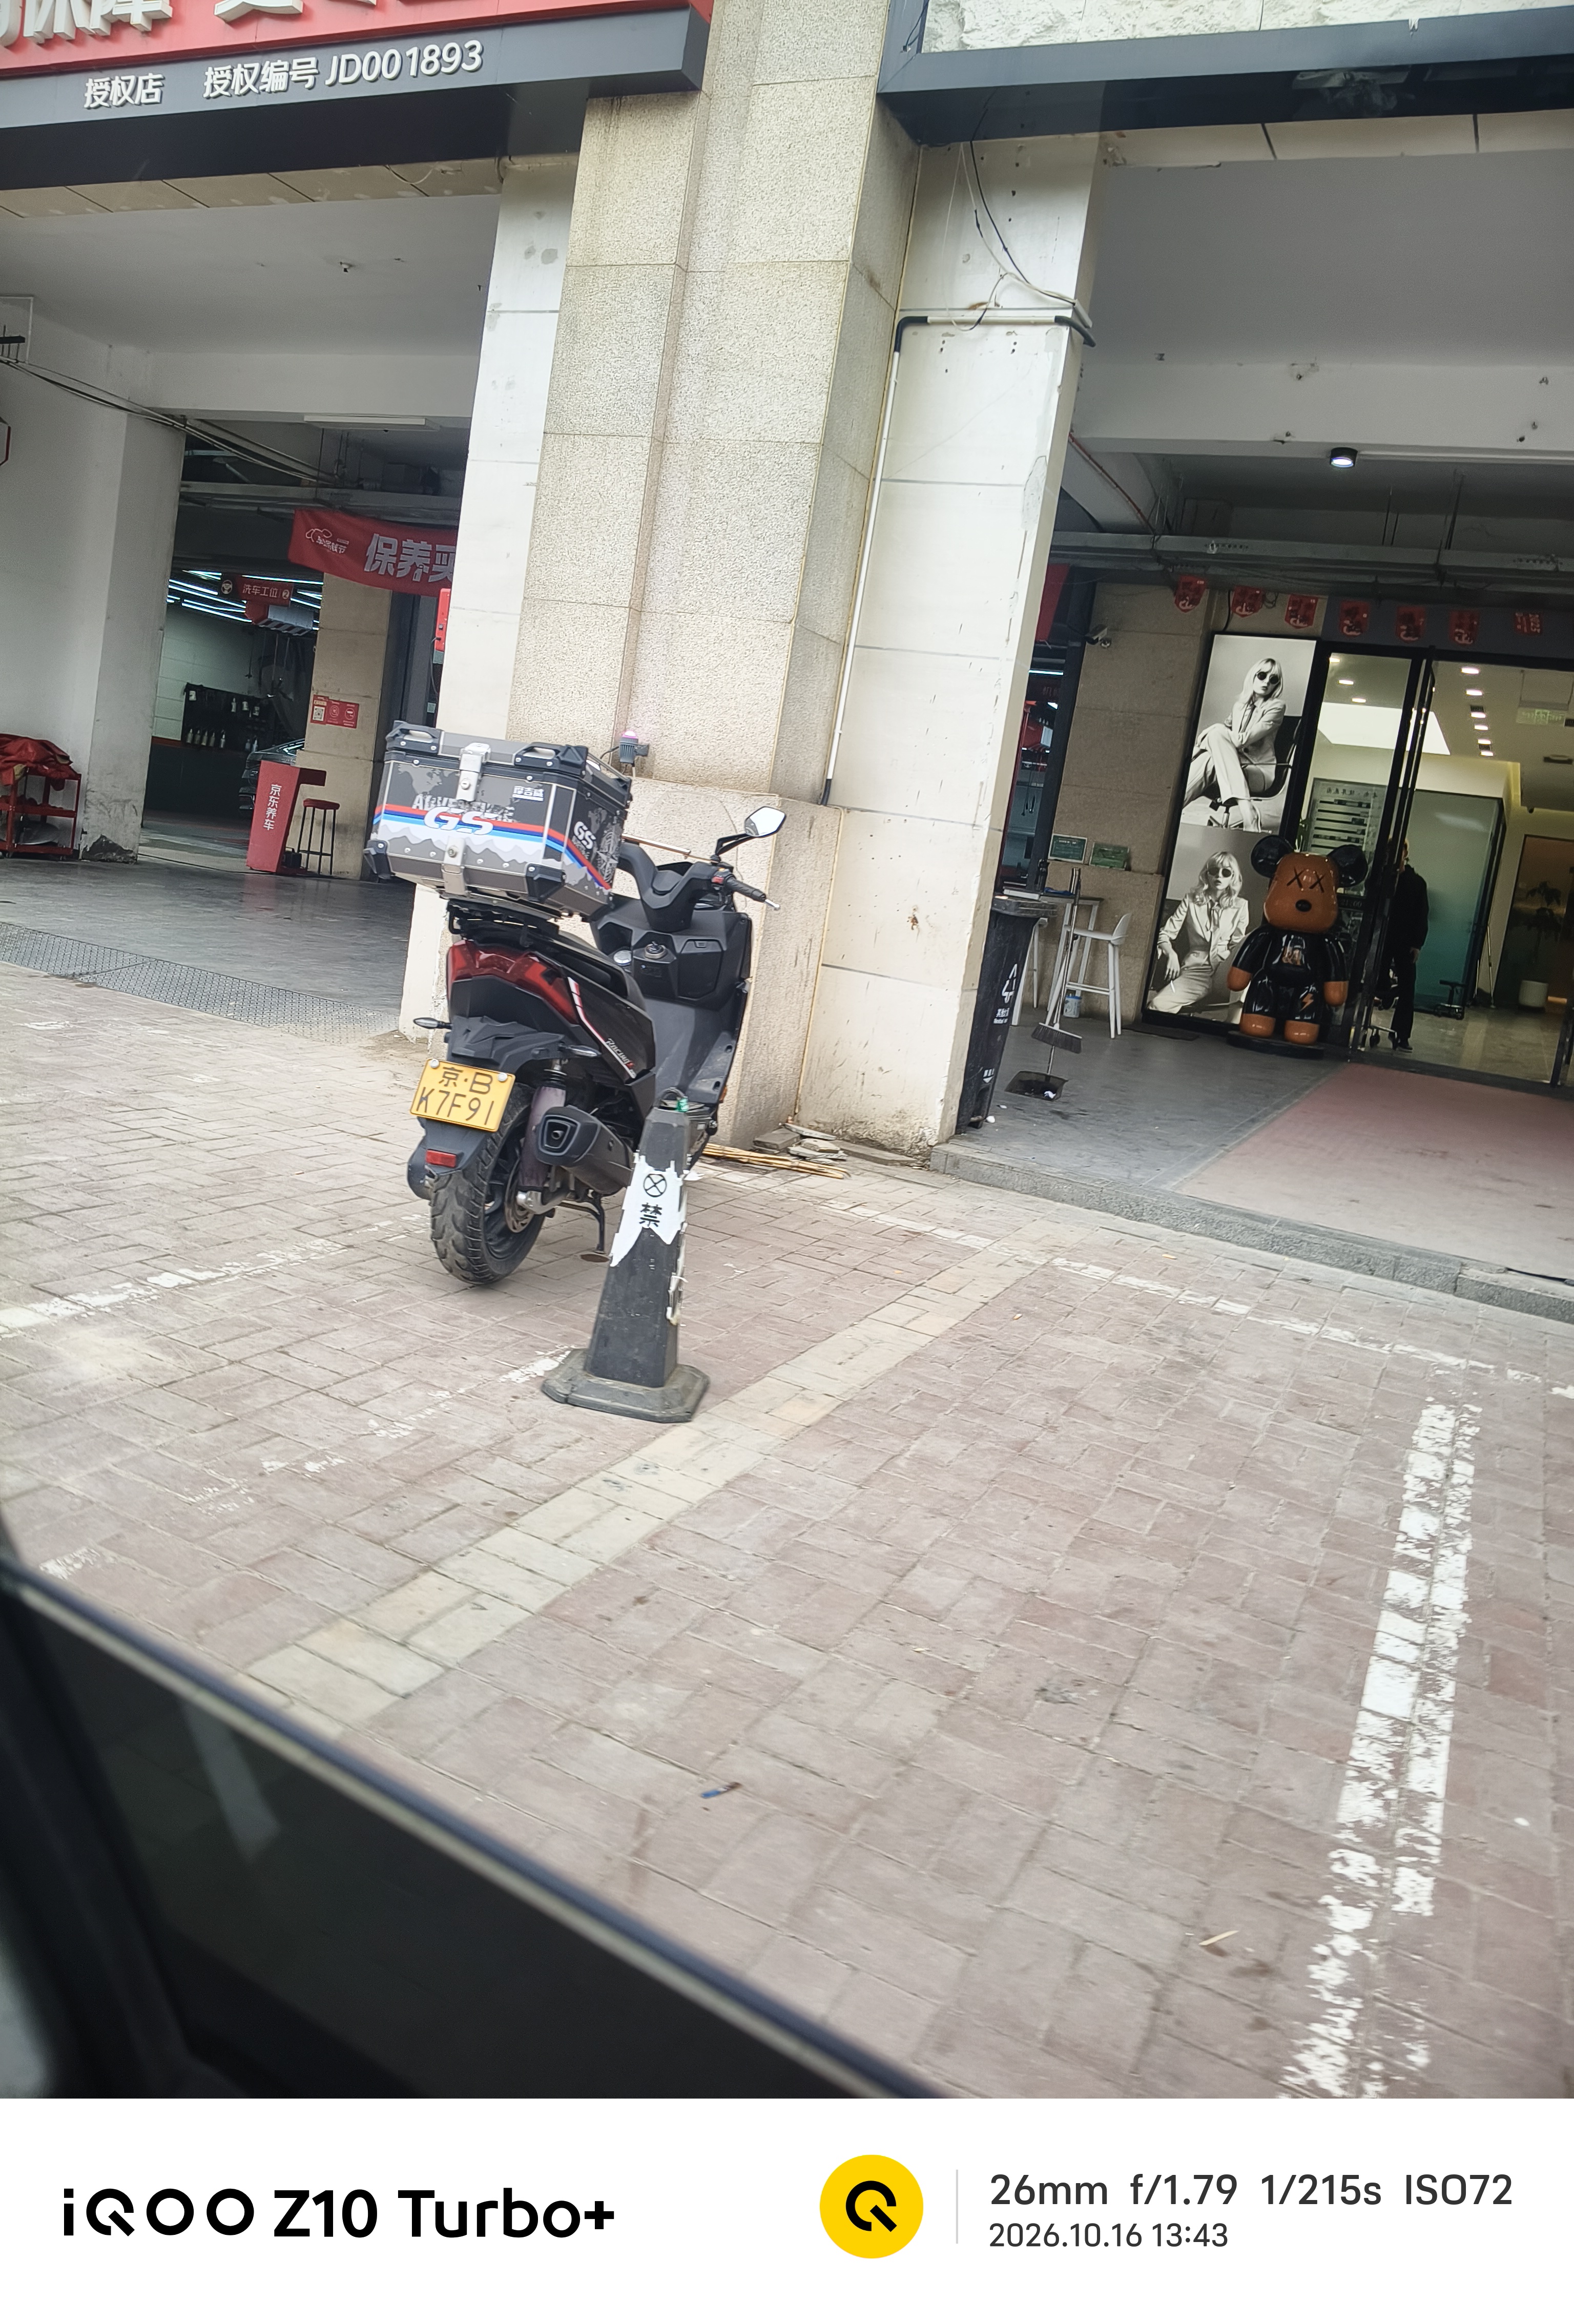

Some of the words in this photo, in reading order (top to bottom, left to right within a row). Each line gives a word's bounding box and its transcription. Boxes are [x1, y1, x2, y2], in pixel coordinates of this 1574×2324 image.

[84, 73, 163, 109] 授权店
[203, 57, 318, 98] 授权编号
[325, 39, 483, 86] JD001893
[242, 584, 278, 598] 洗车工位
[263, 784, 282, 831] 京东养车
[424, 806, 493, 835] GS
[574, 821, 596, 849] GS
[416, 1087, 494, 1126] K7F91
[639, 1202, 662, 1227] 禁
